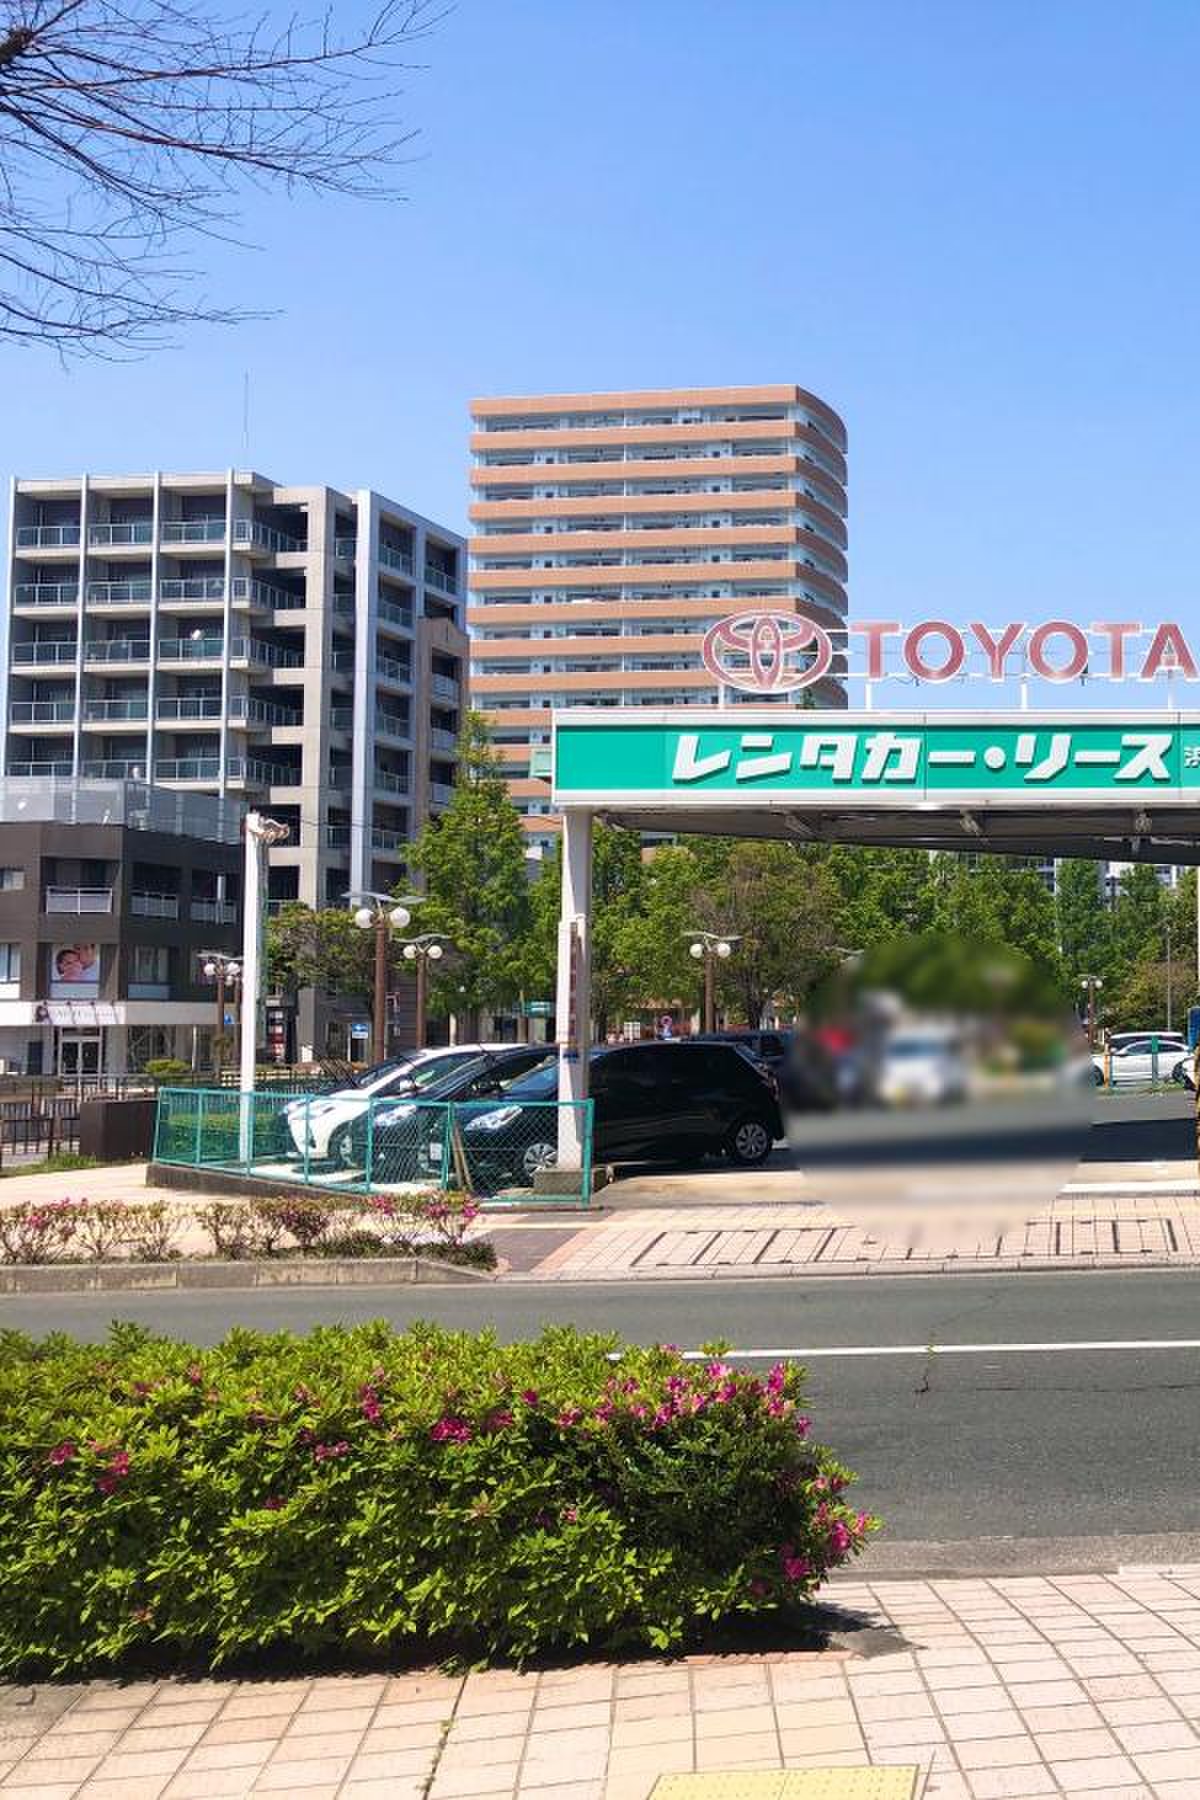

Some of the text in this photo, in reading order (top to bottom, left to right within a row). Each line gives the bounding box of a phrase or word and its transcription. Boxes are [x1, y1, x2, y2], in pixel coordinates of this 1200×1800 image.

[850, 620, 1200, 683] TOYOTA
[671, 732, 1174, 785] レンタカー・リース
